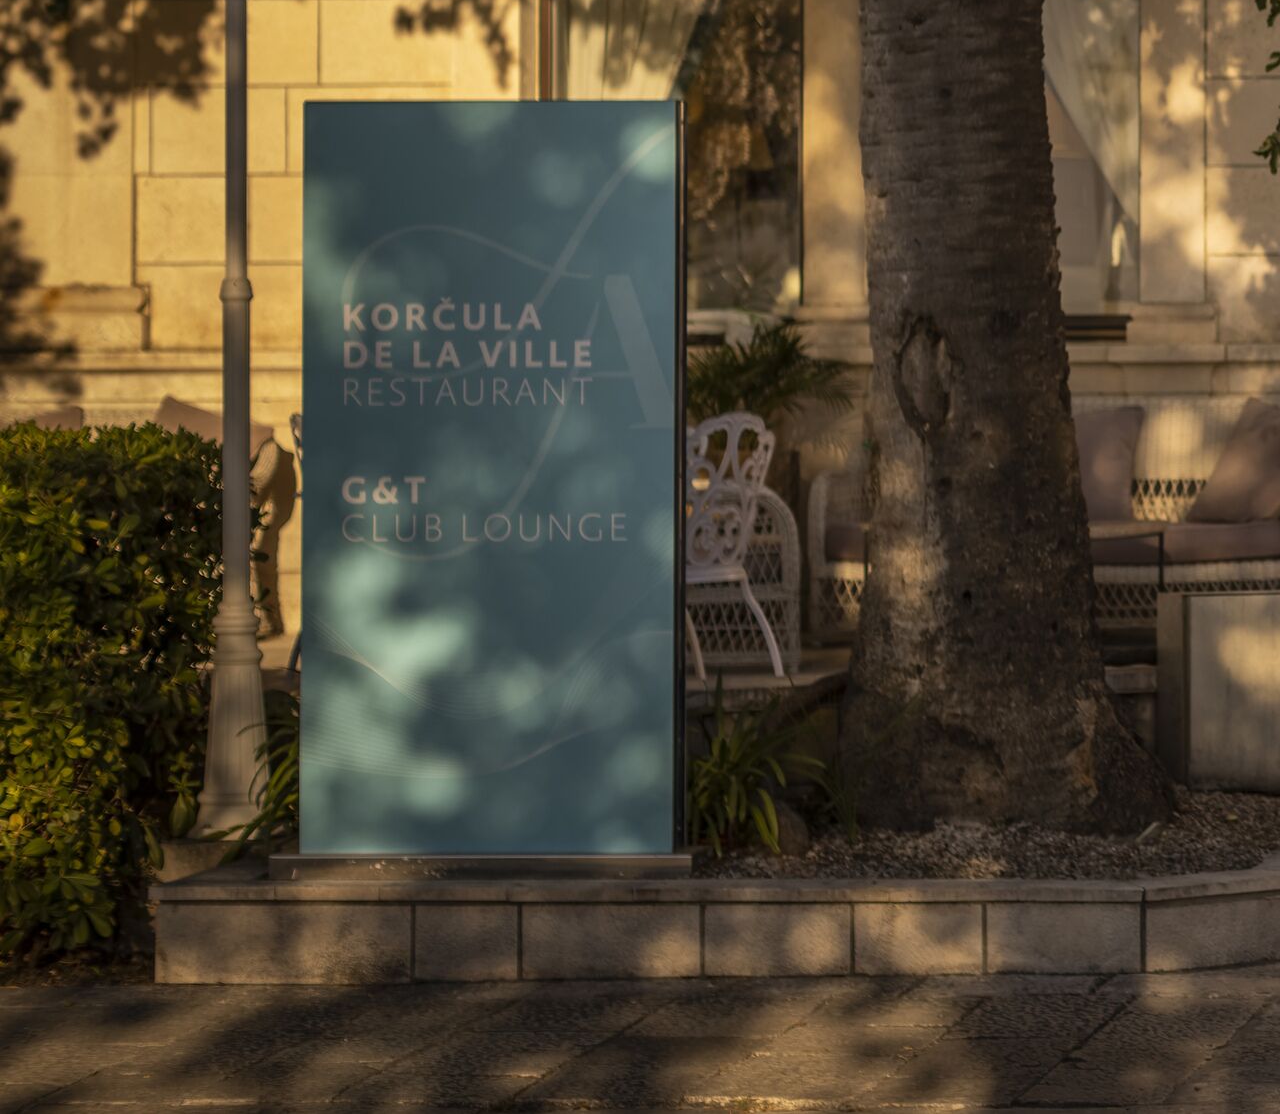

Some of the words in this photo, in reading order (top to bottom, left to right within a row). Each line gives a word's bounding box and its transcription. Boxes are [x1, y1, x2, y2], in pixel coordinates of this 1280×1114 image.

[342, 296, 542, 332] KORČULA
[342, 340, 393, 369] DE
[412, 340, 461, 369] LA
[479, 340, 592, 369] VILLE
[342, 377, 593, 406] RESTAURANT
[341, 476, 426, 505] G&T
[341, 513, 442, 543] CLUB
[461, 513, 628, 543] LOUNGE
